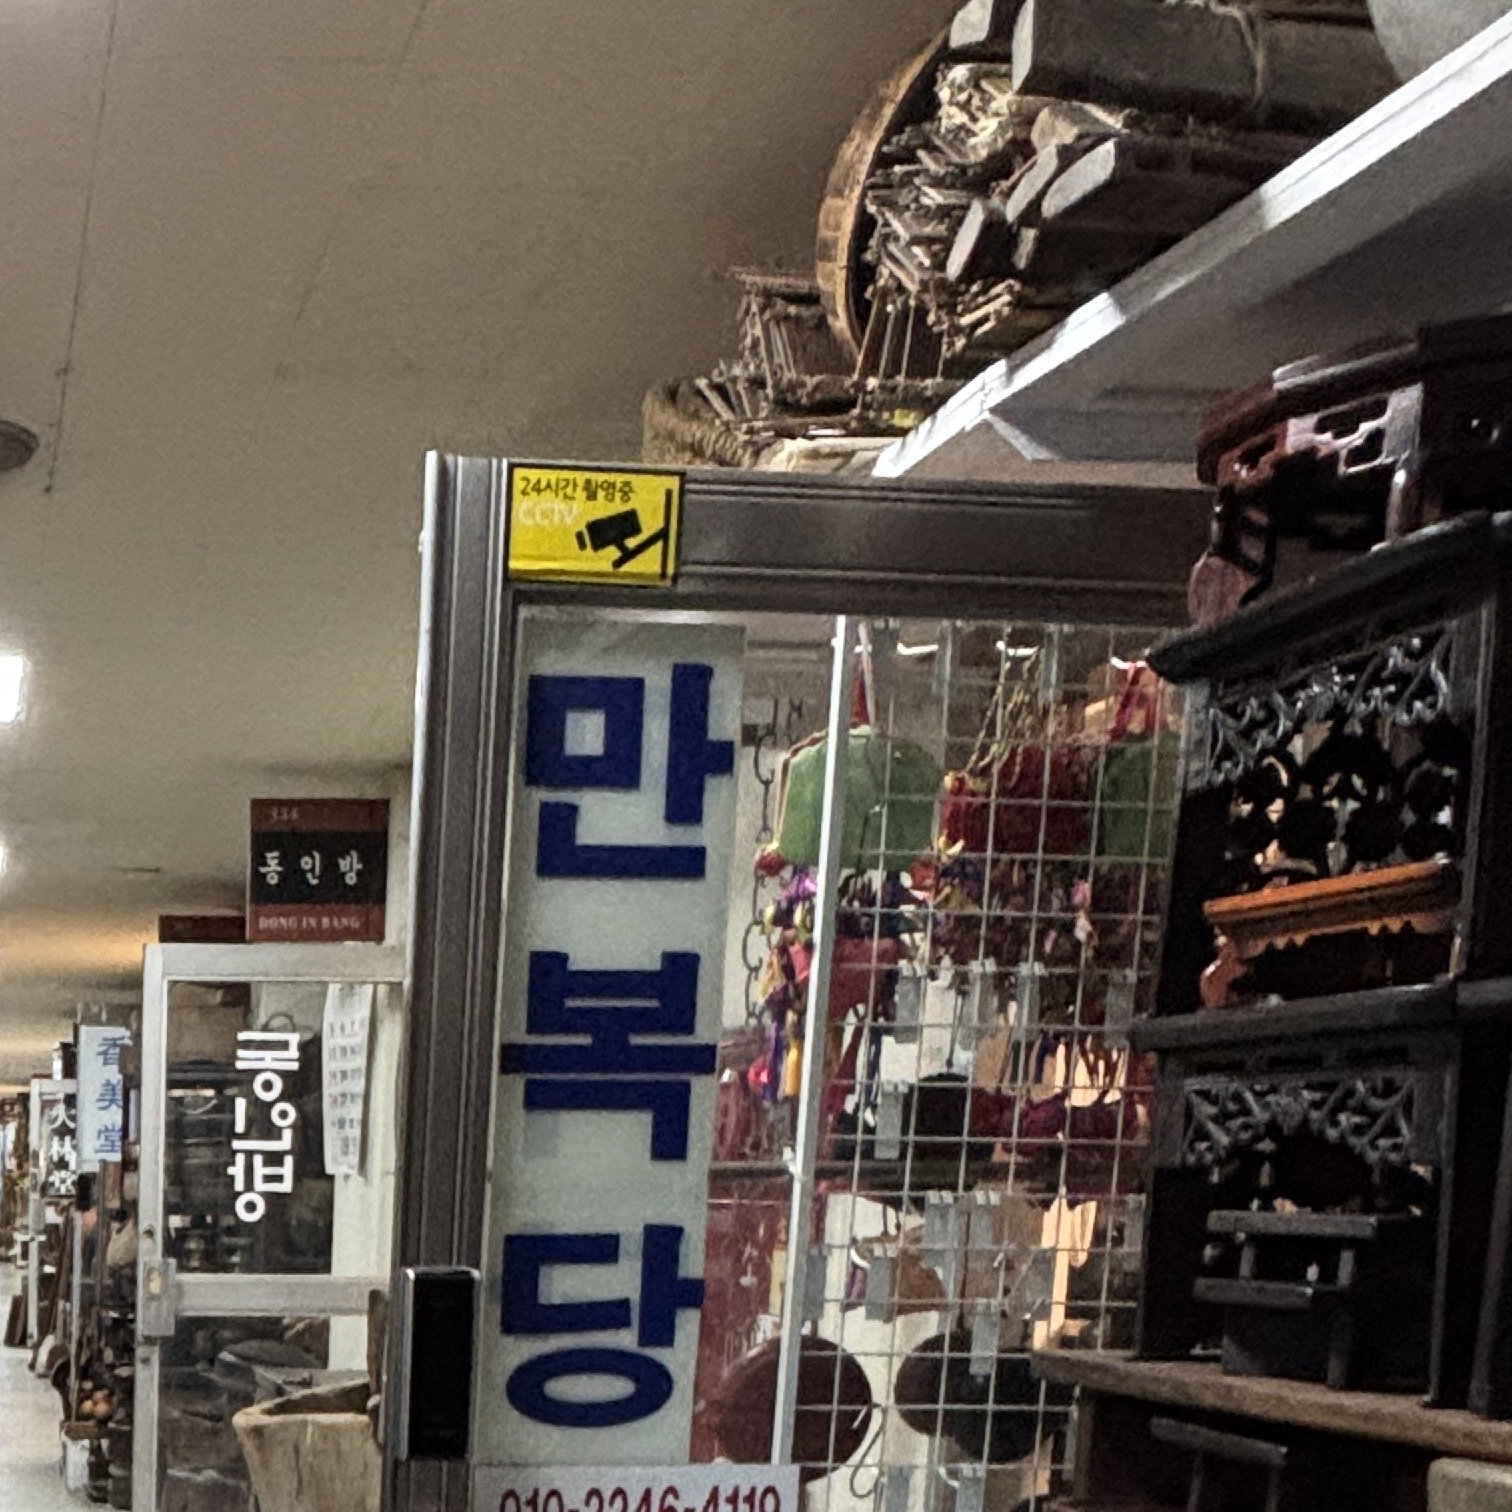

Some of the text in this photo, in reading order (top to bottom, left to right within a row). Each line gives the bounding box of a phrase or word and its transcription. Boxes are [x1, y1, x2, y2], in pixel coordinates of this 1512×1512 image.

[520, 477, 636, 503] 24시간 촬영중
[258, 850, 363, 886] 동인방
[499, 662, 735, 1430] 만복당
